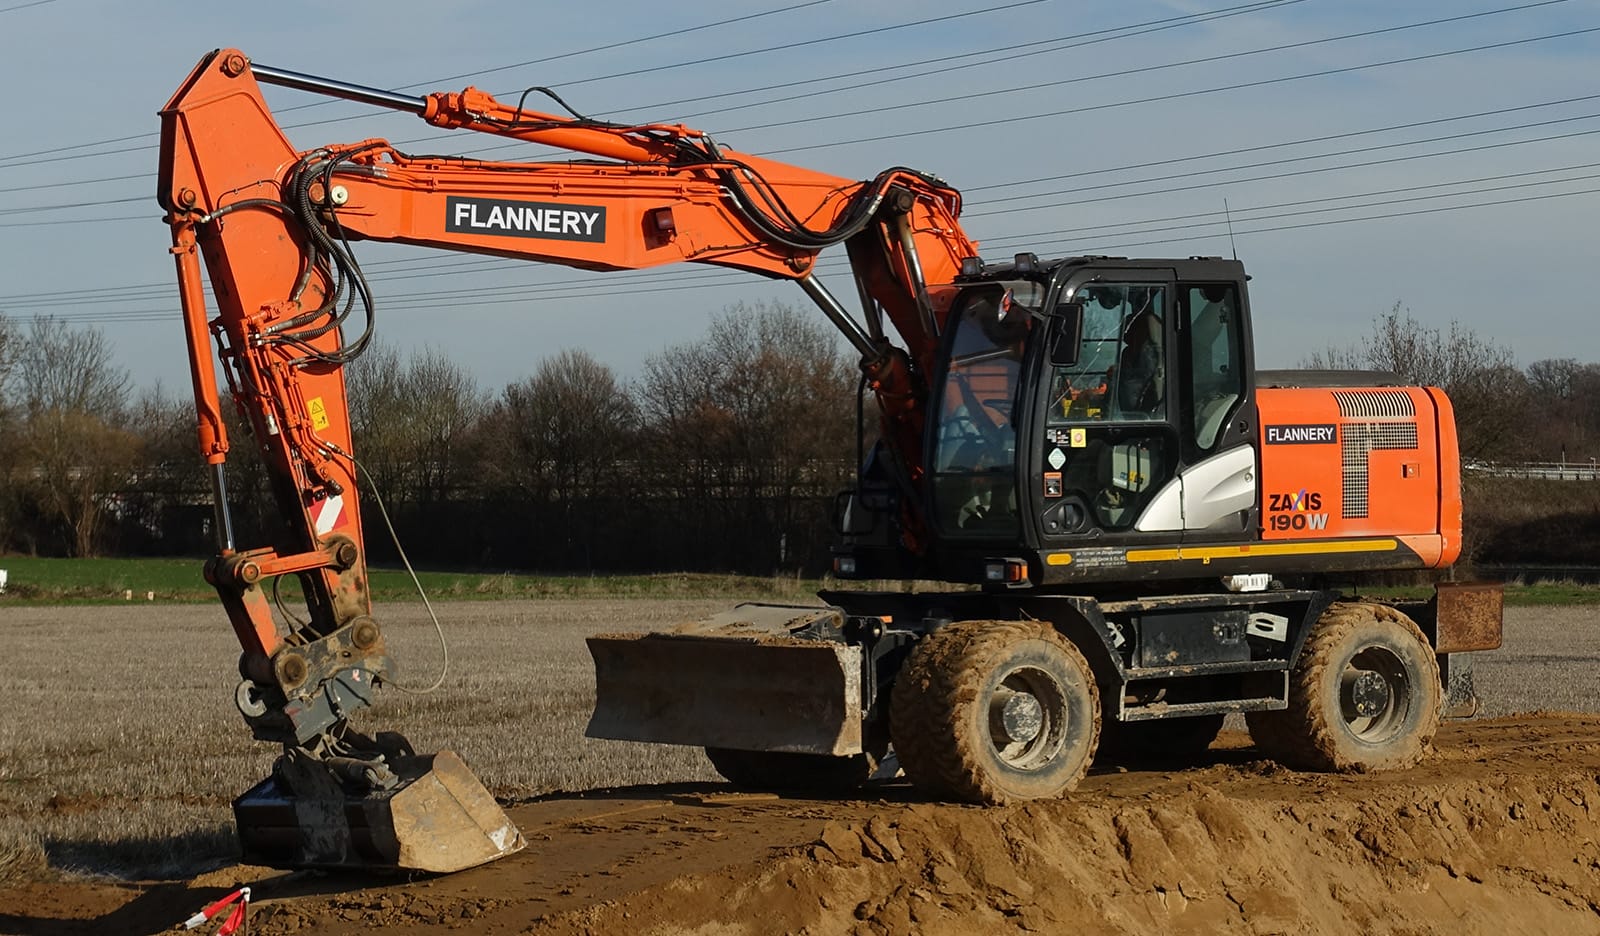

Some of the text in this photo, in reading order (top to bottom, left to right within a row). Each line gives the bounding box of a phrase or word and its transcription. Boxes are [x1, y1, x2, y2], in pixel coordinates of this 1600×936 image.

[455, 203, 600, 235] FLANNERY
[1268, 427, 1334, 441] FLANNERY
[1269, 489, 1322, 511] ZAXIS
[1269, 512, 1329, 531] 190W
